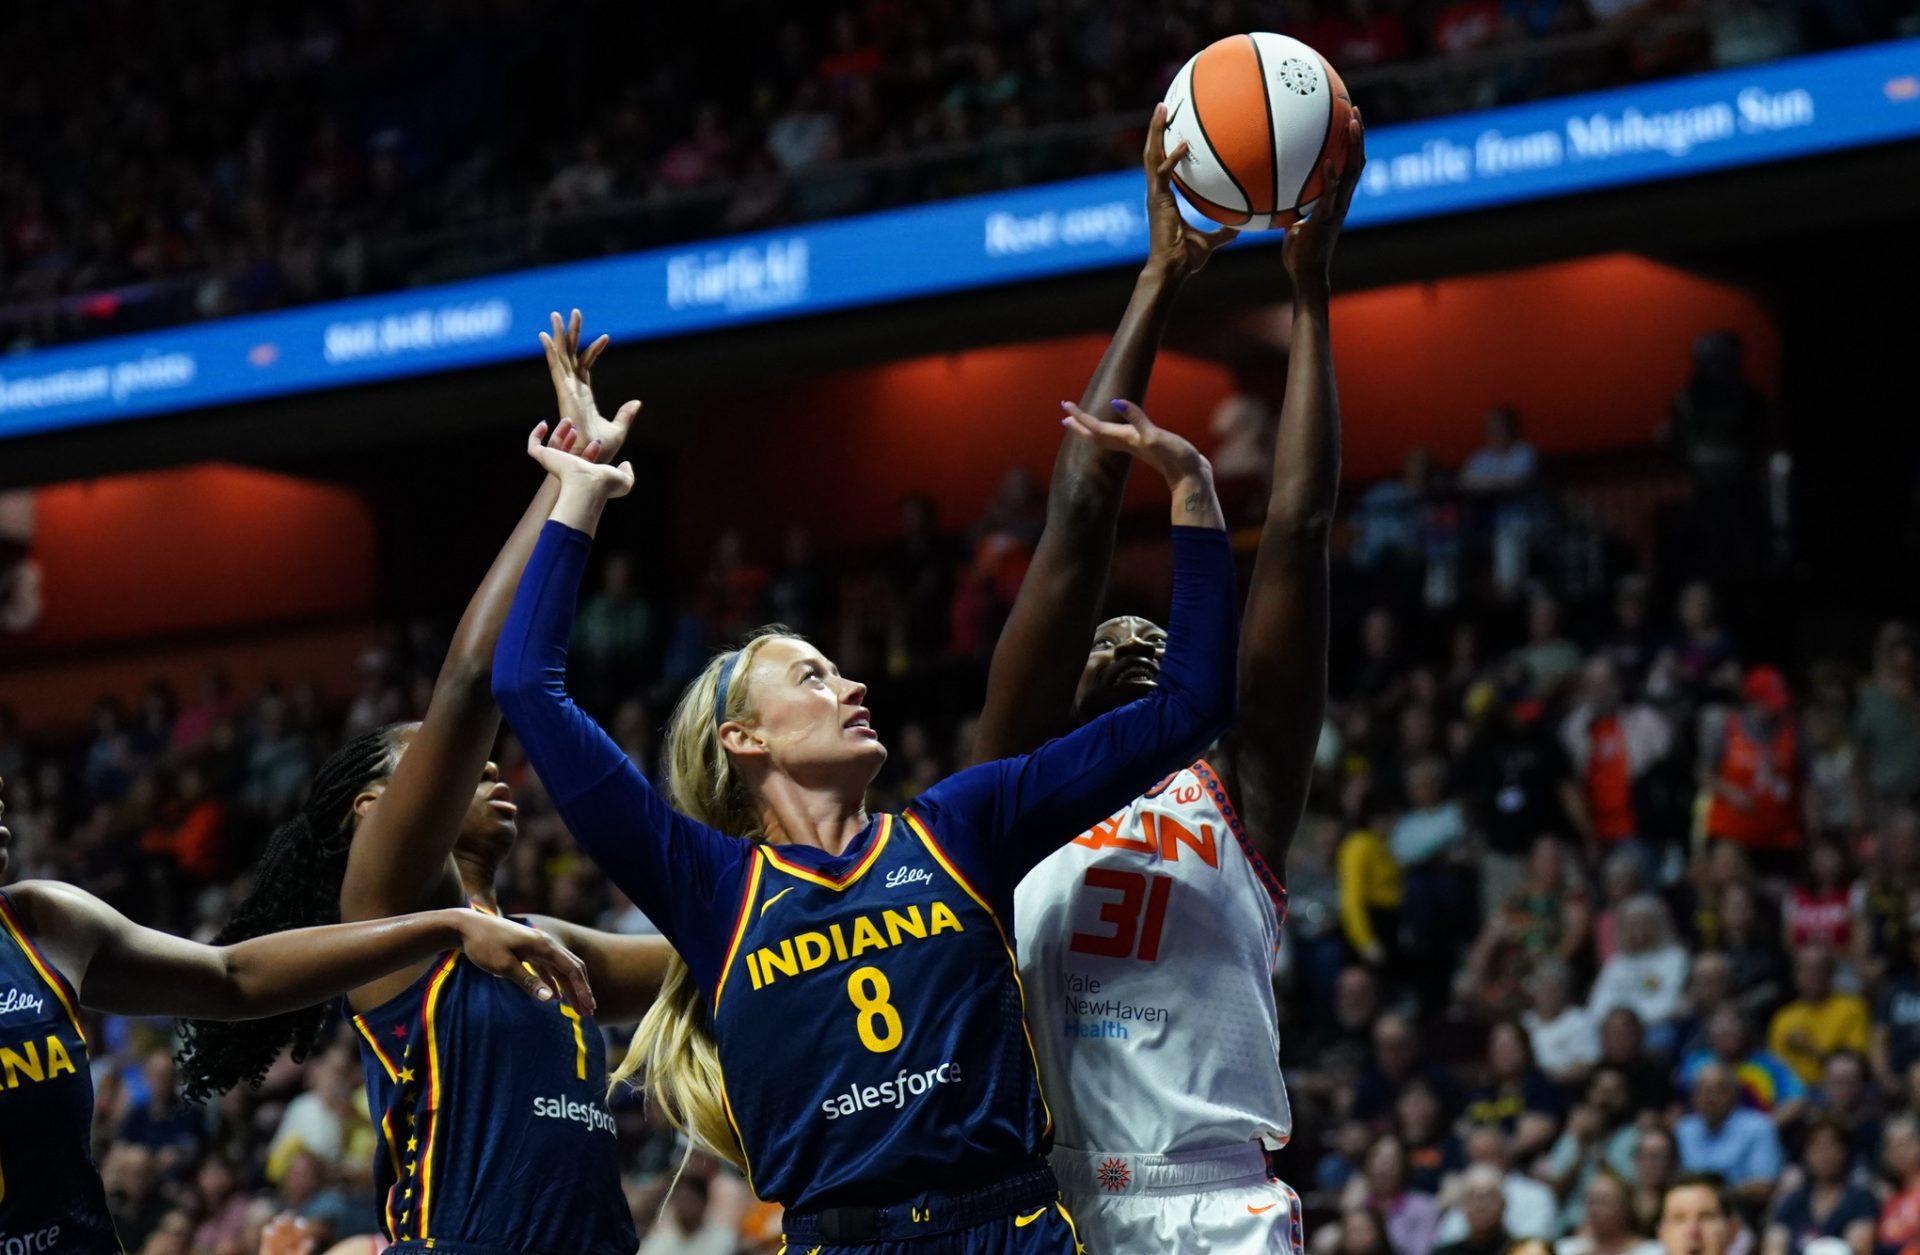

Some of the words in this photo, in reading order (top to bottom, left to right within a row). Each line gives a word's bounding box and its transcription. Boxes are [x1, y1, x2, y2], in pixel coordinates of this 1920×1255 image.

[1475, 130, 1563, 175] from
[1567, 108, 1736, 160] Mohegan
[1737, 86, 1814, 134] Sun
[884, 865, 934, 889] Lilly
[1069, 866, 1172, 962] 31
[745, 901, 965, 991] INDIANA
[846, 966, 903, 1054] 8
[1063, 972, 1101, 994] Yale
[1064, 995, 1169, 1022] NewHaven
[1063, 1019, 1128, 1040] Health
[0, 1034, 76, 1091] NA
[821, 1061, 962, 1121] salesforce
